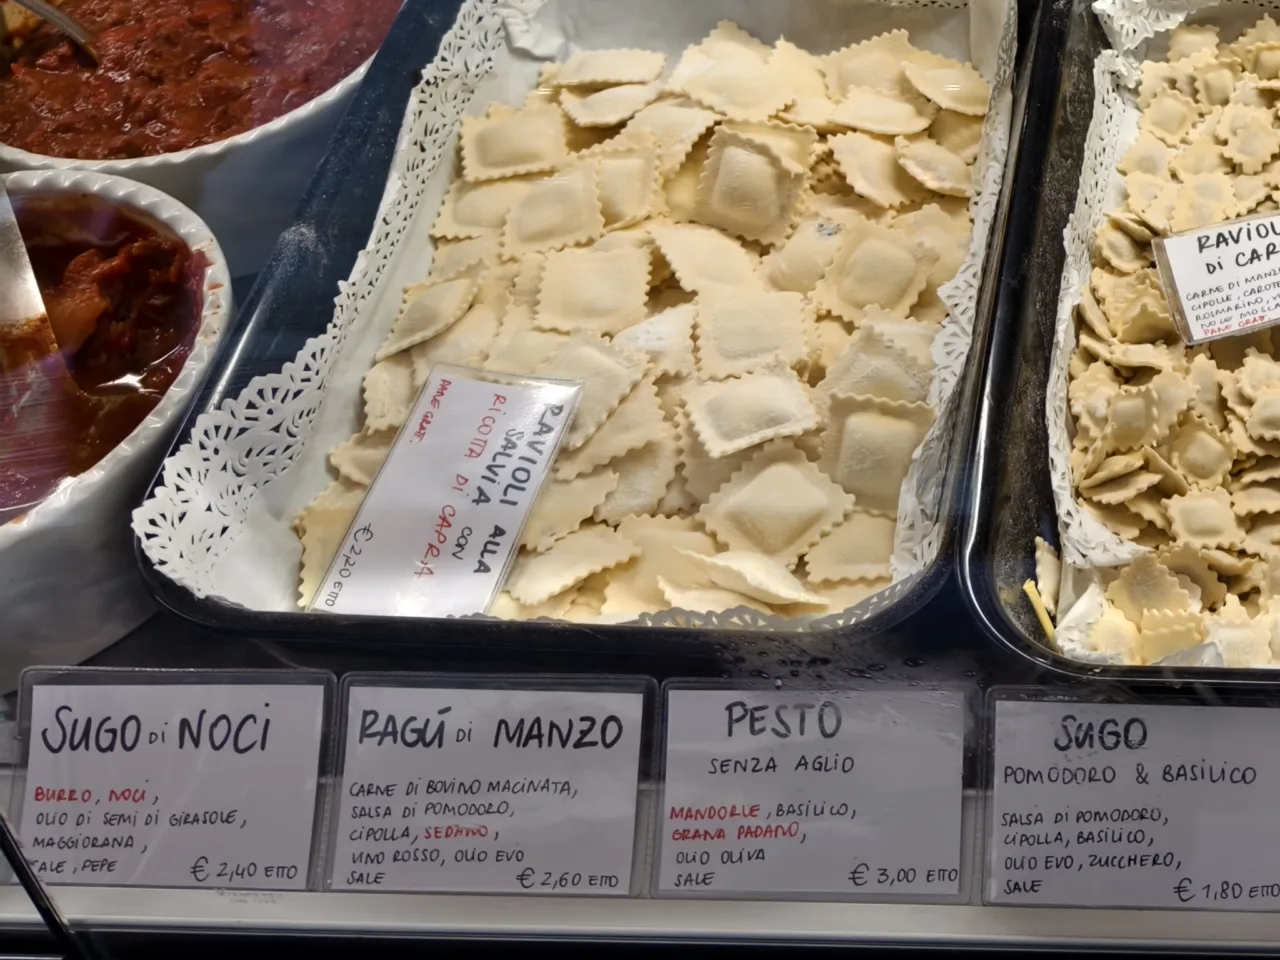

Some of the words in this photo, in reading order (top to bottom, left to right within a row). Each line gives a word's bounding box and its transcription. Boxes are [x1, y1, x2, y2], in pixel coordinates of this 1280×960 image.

[1206, 258, 1224, 275] DI
[1185, 284, 1224, 302] CARNE
[1227, 278, 1241, 292] DI
[1203, 323, 1232, 337] PANE
[430, 378, 452, 410] PANE
[464, 393, 507, 459] RICOTTA
[499, 403, 565, 507] RAVIOLI
[472, 428, 524, 507] SALVIA
[414, 505, 456, 579] CAPRA
[451, 526, 473, 560] CON
[473, 524, 507, 574] ALLA
[41, 705, 141, 754] SUGO
[178, 702, 271, 755] NOCI
[724, 700, 843, 739] PESTO
[493, 714, 623, 750] MANZO
[1053, 714, 1148, 752] SUGO
[708, 757, 778, 774] SENZA
[794, 753, 855, 773] AGLIO
[1003, 764, 1116, 785] POMODORO
[1135, 763, 1149, 785] &
[1162, 759, 1257, 785] BASILICO
[349, 782, 398, 797] CARNE
[406, 777, 422, 795] DI
[426, 779, 481, 795] BOVINO
[36, 810, 68, 827] OLIO
[76, 811, 91, 826] DI
[103, 810, 137, 827] SEMI
[144, 810, 159, 826] DI
[351, 804, 392, 819] SALSA
[402, 802, 418, 819] DI
[1000, 811, 1044, 827] SALSA
[1054, 805, 1069, 824] DI
[672, 828, 726, 841] GRANA
[81, 859, 118, 872] PEPE
[351, 851, 385, 865] VINO
[454, 848, 488, 863] OLIO
[495, 849, 525, 863] EVO
[676, 850, 710, 866] OLIO
[720, 848, 765, 865] OLIVA
[1005, 855, 1037, 870] OLIO
[265, 864, 298, 880] ETTO
[347, 871, 386, 885] SALE
[588, 874, 619, 888] ETTO
[674, 871, 715, 887] SALE
[926, 868, 959, 883] ETTO
[1003, 879, 1044, 895] SALE
[1248, 883, 1280, 898] ETTO
